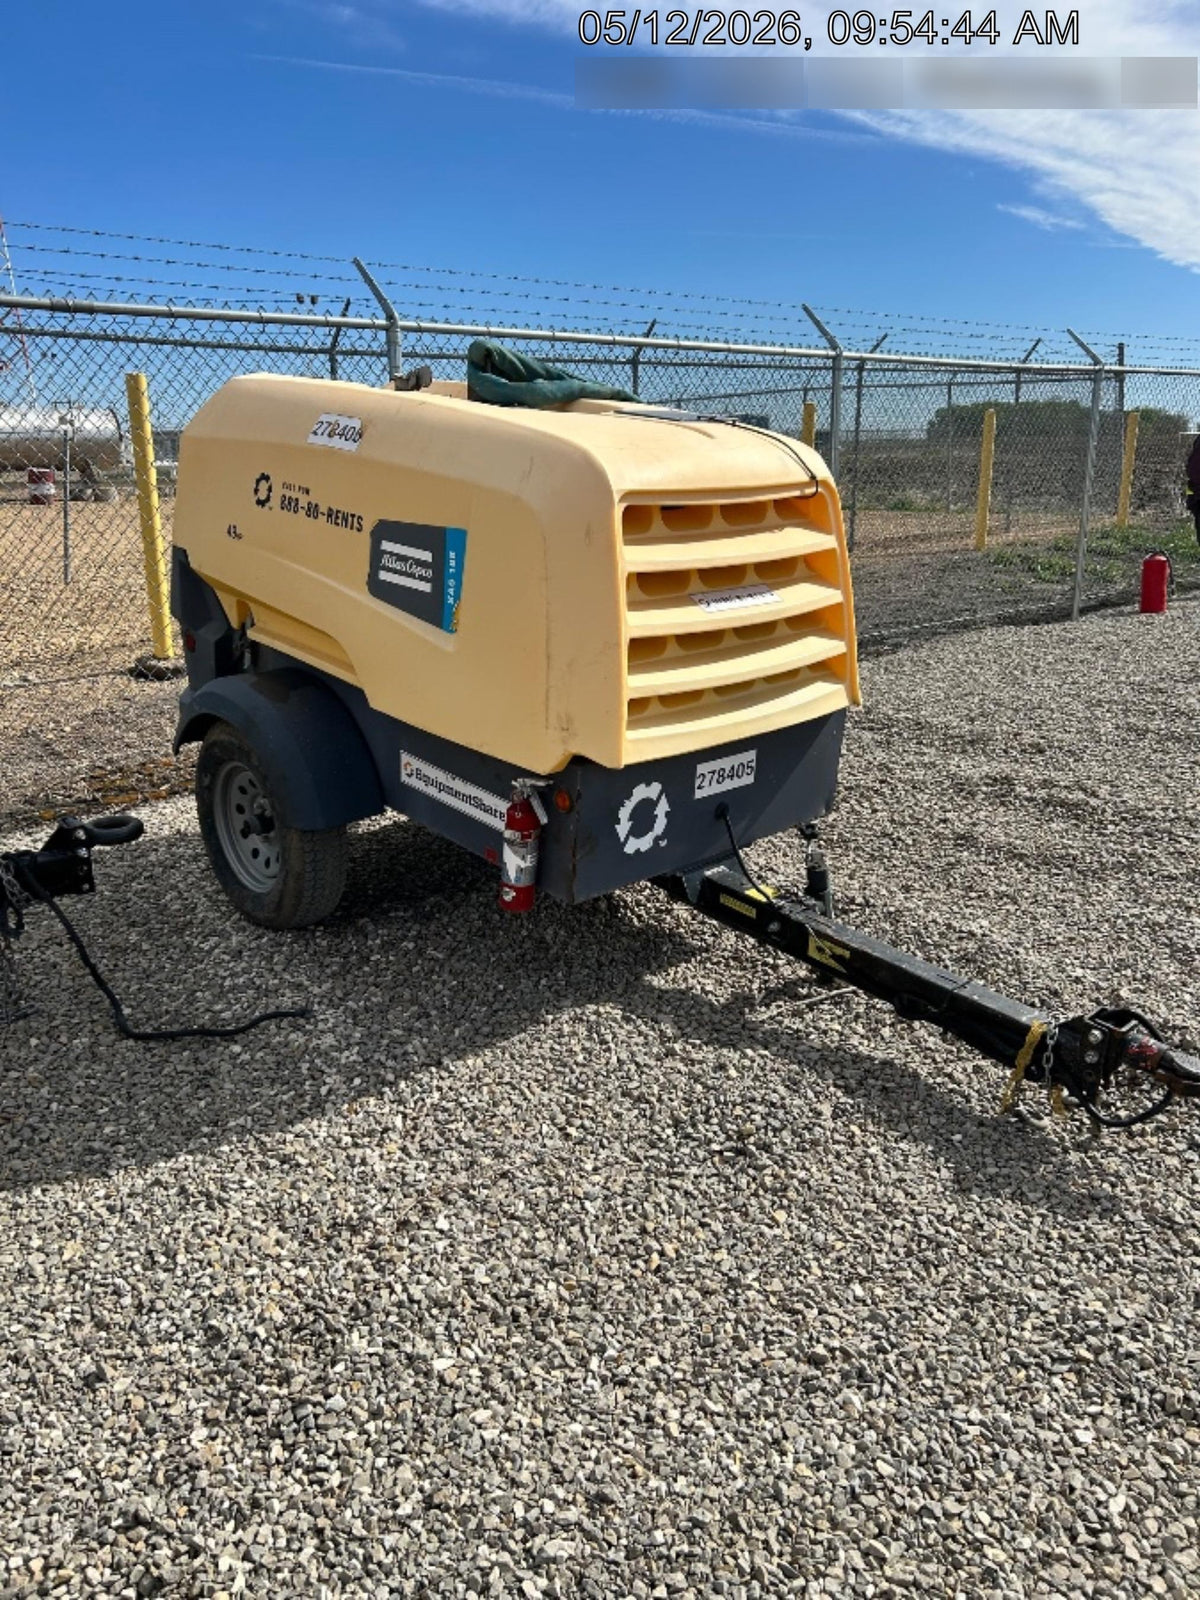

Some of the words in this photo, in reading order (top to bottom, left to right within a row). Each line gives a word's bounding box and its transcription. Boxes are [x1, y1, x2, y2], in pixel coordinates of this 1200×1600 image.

[280, 494, 364, 532] 888-80-RENTS
[380, 554, 406, 571] Atlas
[406, 559, 433, 578] Copco
[695, 760, 755, 790] 278405
[415, 767, 506, 822] EquipmentShare
